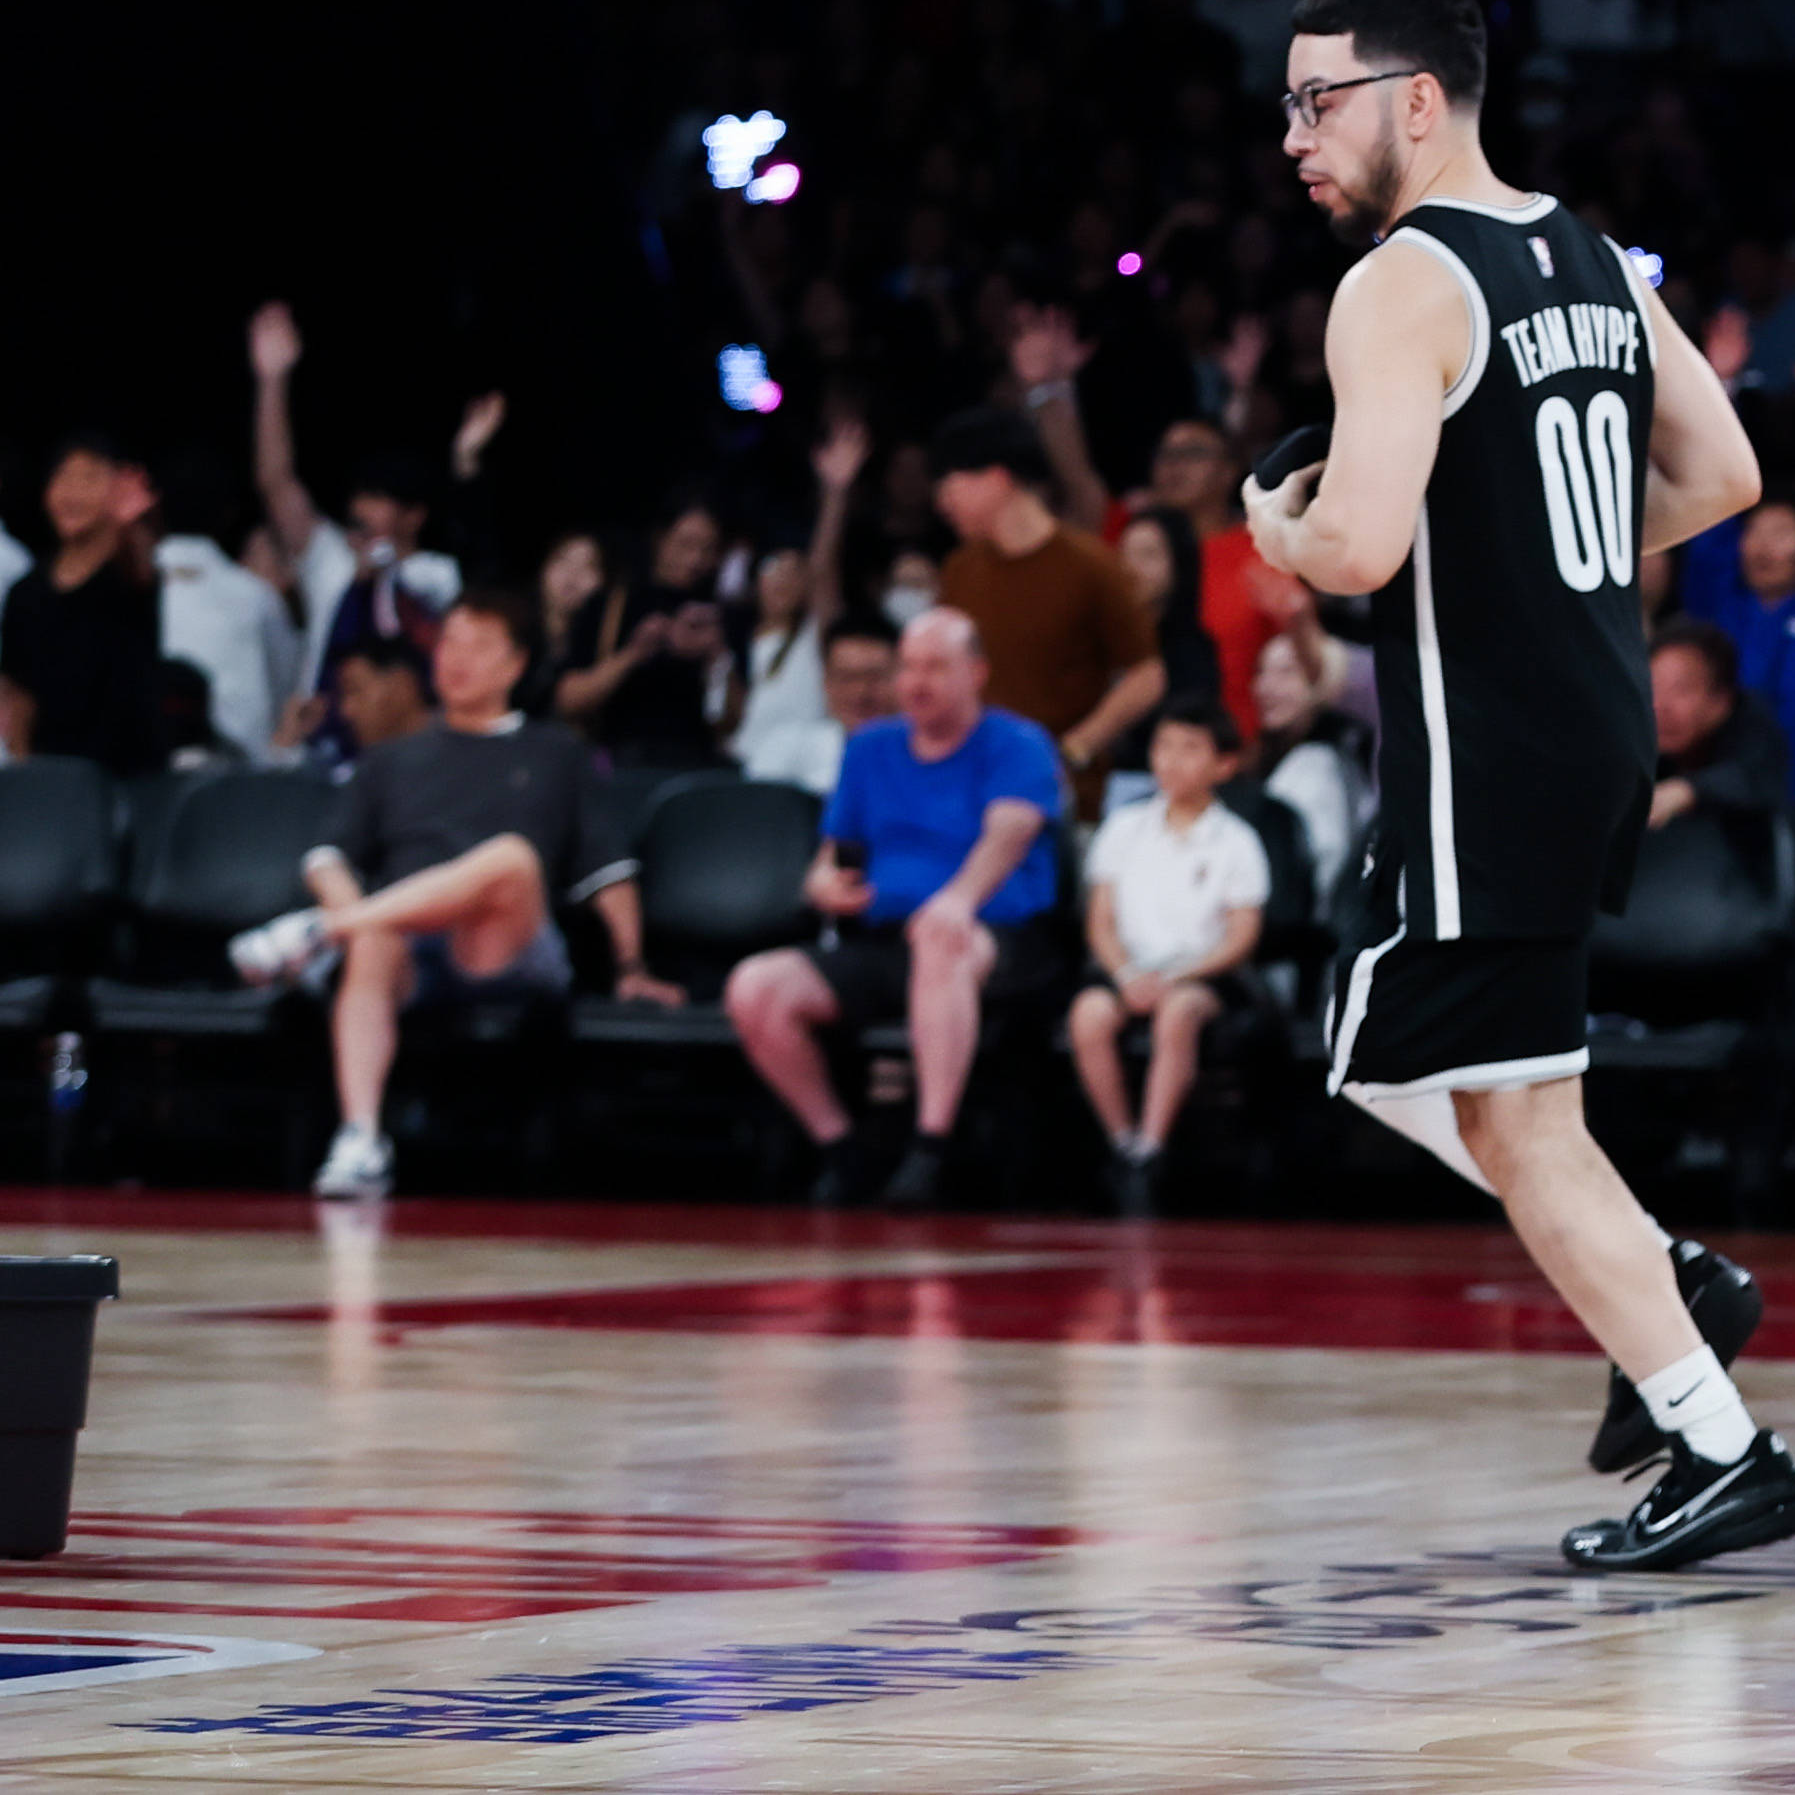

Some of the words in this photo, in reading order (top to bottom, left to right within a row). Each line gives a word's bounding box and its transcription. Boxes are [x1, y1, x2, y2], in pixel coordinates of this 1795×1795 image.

[1500, 305, 1578, 388] TEAM
[1567, 302, 1640, 376] HYPE
[1534, 389, 1634, 594] 00
